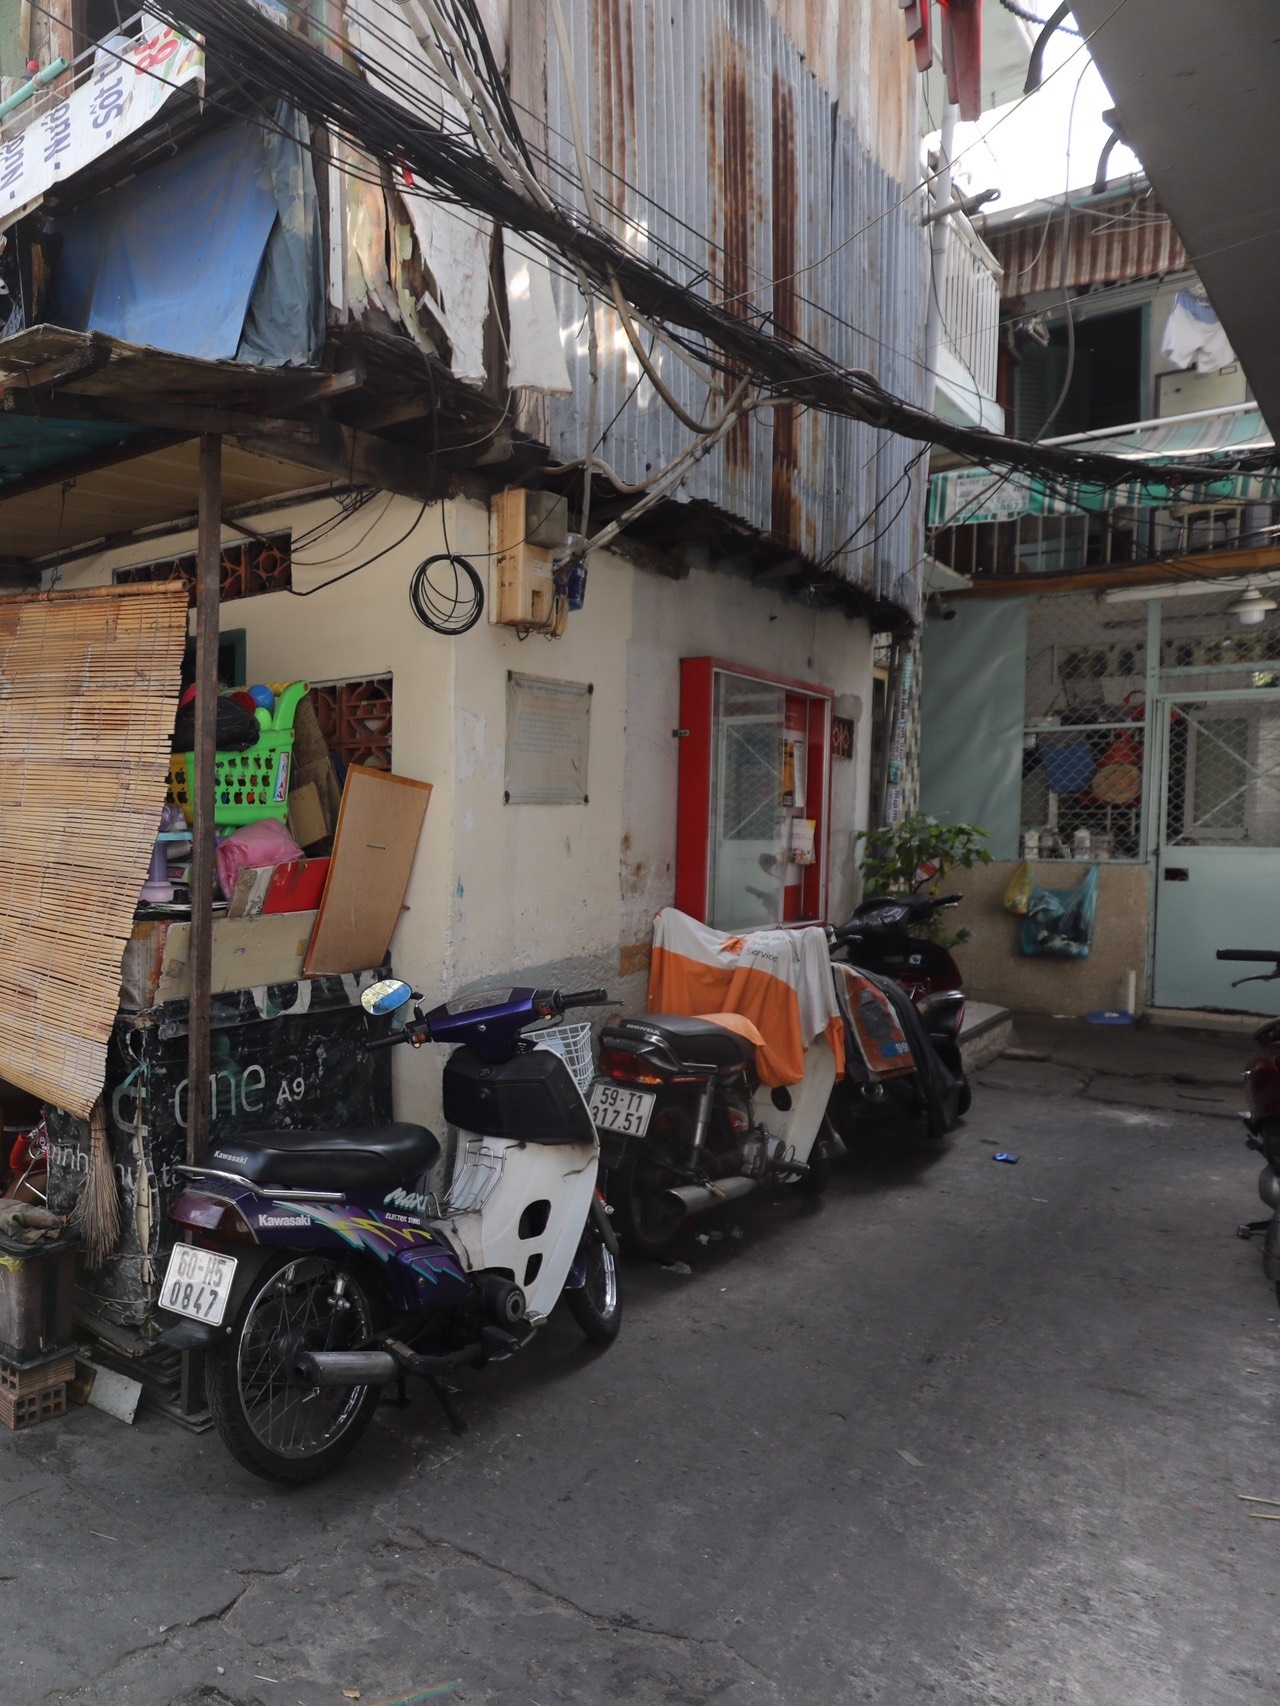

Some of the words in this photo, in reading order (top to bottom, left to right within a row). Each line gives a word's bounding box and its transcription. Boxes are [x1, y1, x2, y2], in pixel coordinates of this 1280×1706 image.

[90, 76, 124, 129] Sốt
[746, 946, 779, 963] Service
[625, 1023, 661, 1036] HONDA
[276, 1077, 306, 1105] A9
[600, 1086, 644, 1113] 59-T1
[213, 1150, 248, 1165] Kawasaki
[383, 1186, 428, 1213] MAXI
[258, 1213, 312, 1227] Kawasaki
[384, 1212, 408, 1223] ELECTRIC
[170, 1280, 219, 1318] 0847
